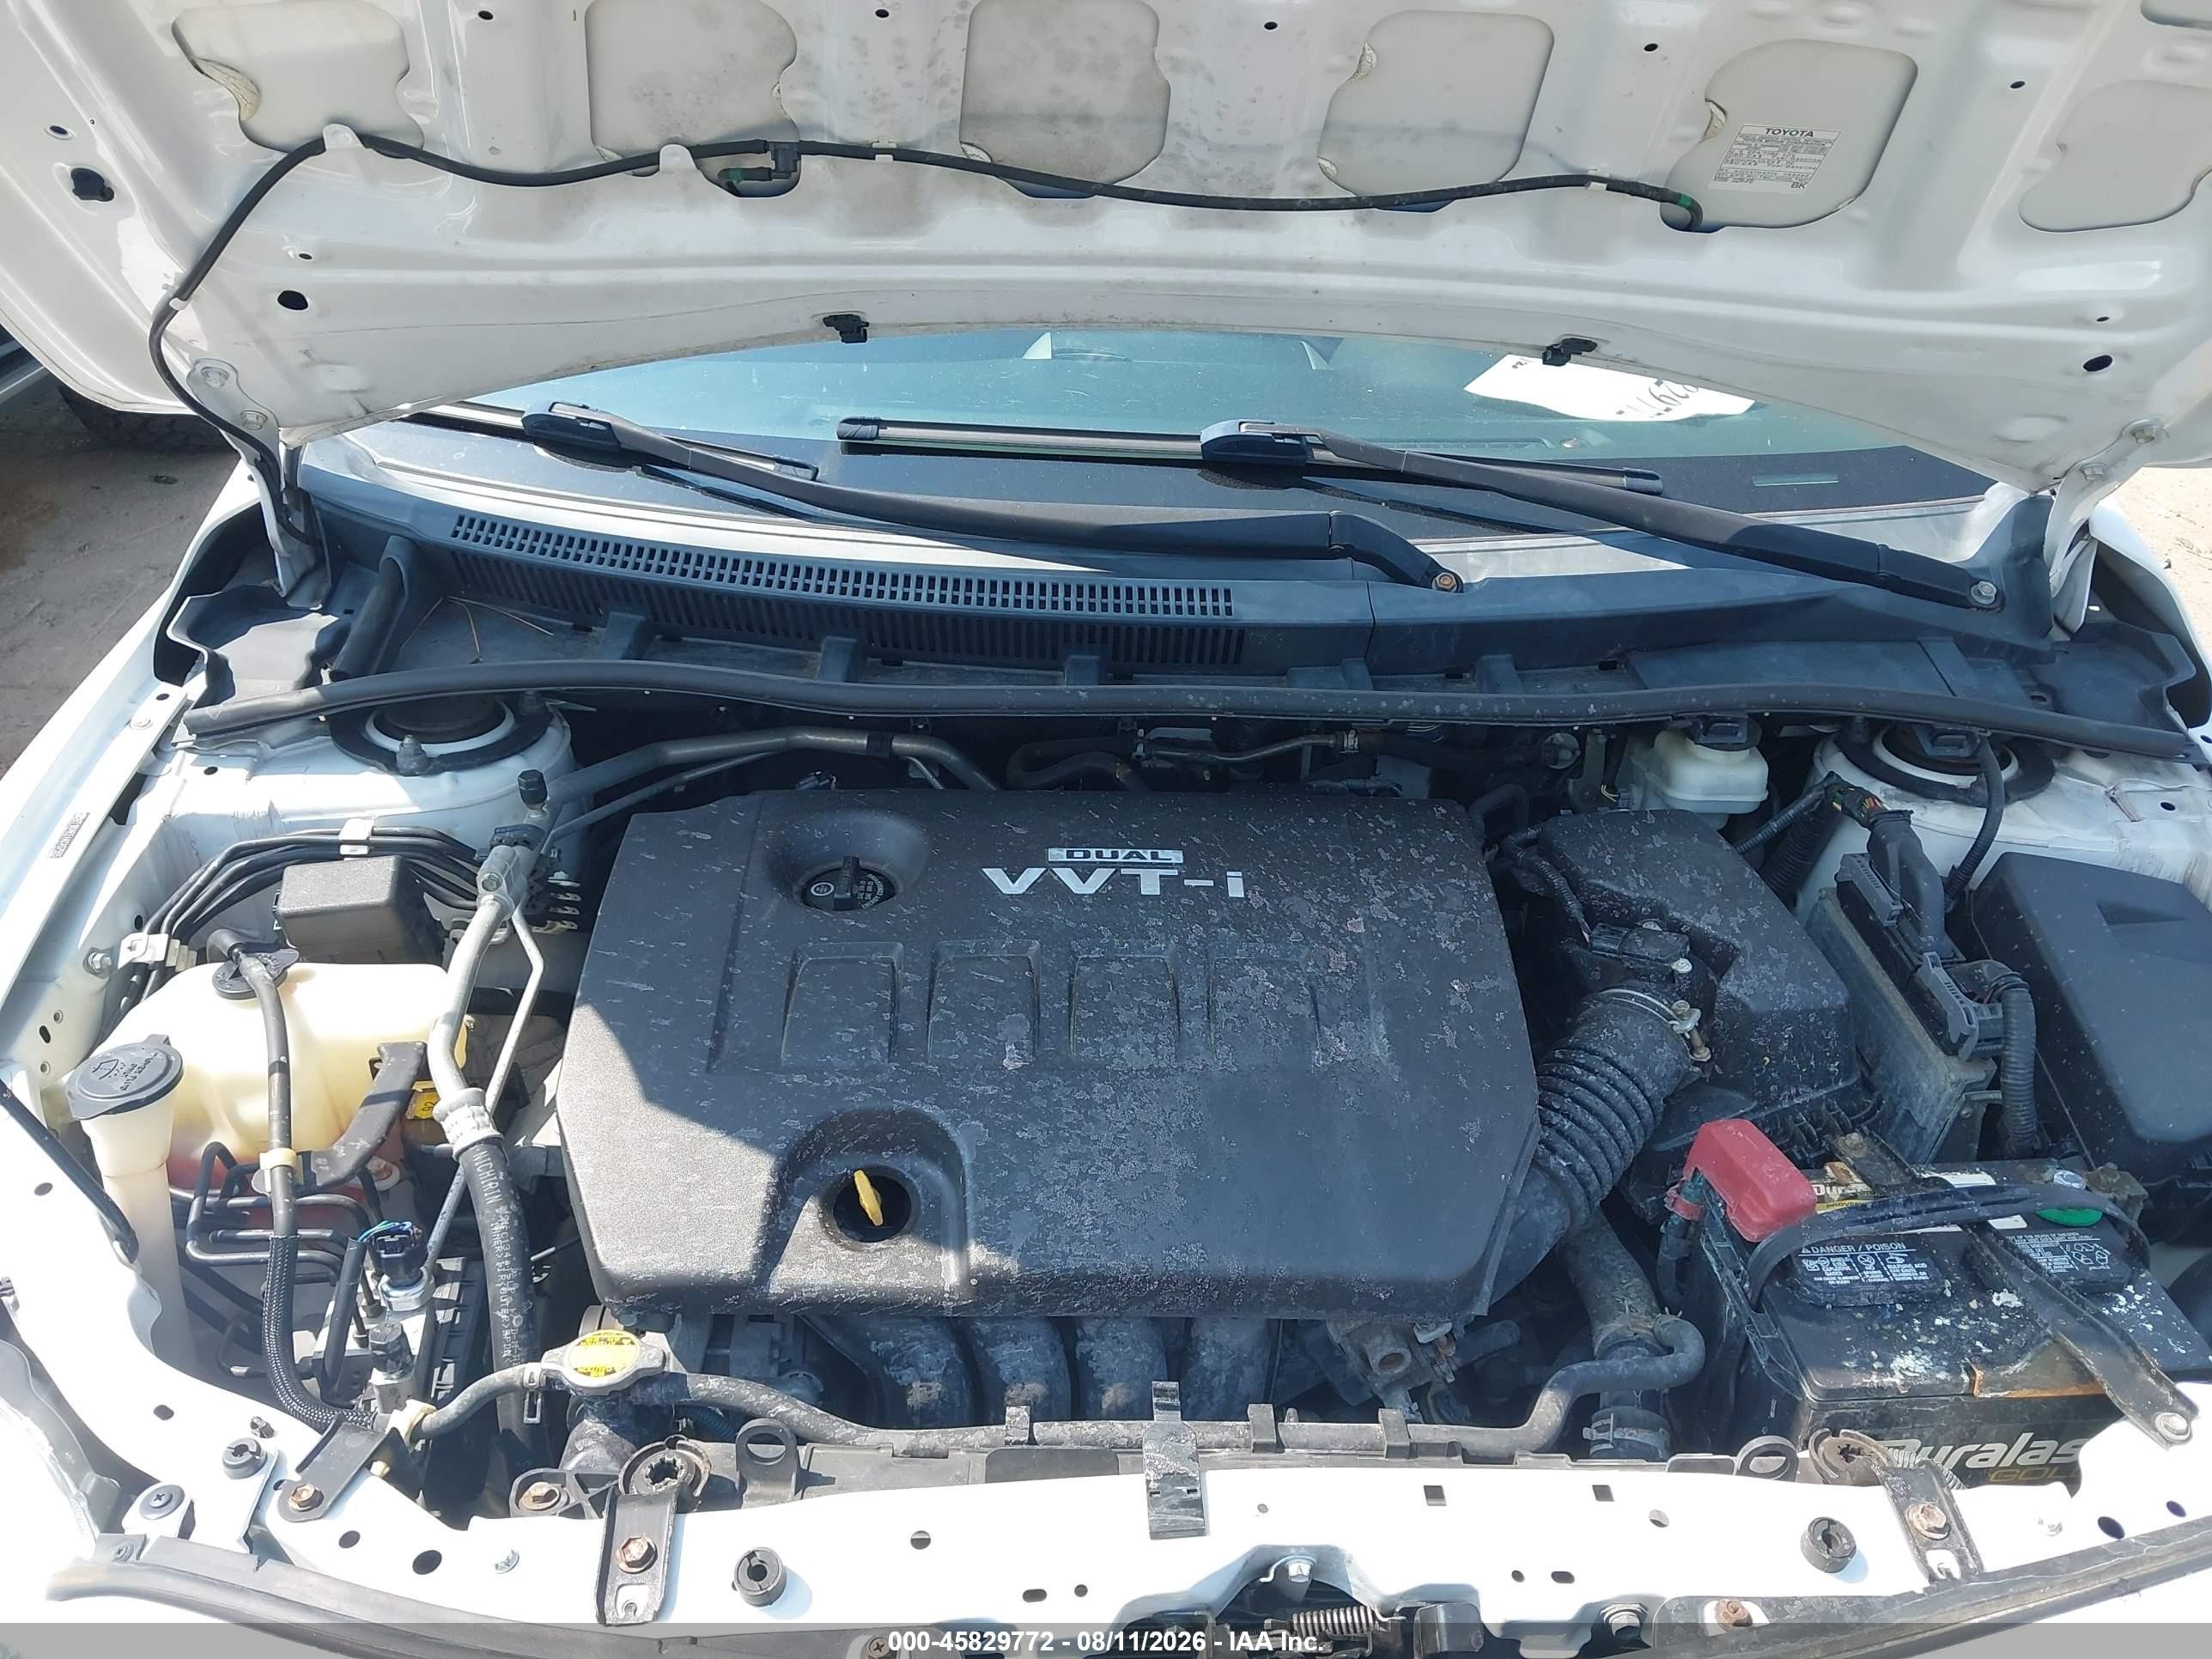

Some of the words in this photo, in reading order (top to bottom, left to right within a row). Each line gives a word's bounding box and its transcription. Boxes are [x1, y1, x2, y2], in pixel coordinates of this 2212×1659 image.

[1765, 128, 1814, 137] TOYOTA
[1066, 850, 1172, 860] DUAL
[981, 867, 1245, 898] VVT-i
[473, 1151, 502, 1205] NICHIRIN
[1810, 1244, 1856, 1254] DANGER
[1866, 1242, 1906, 1251] POISON
